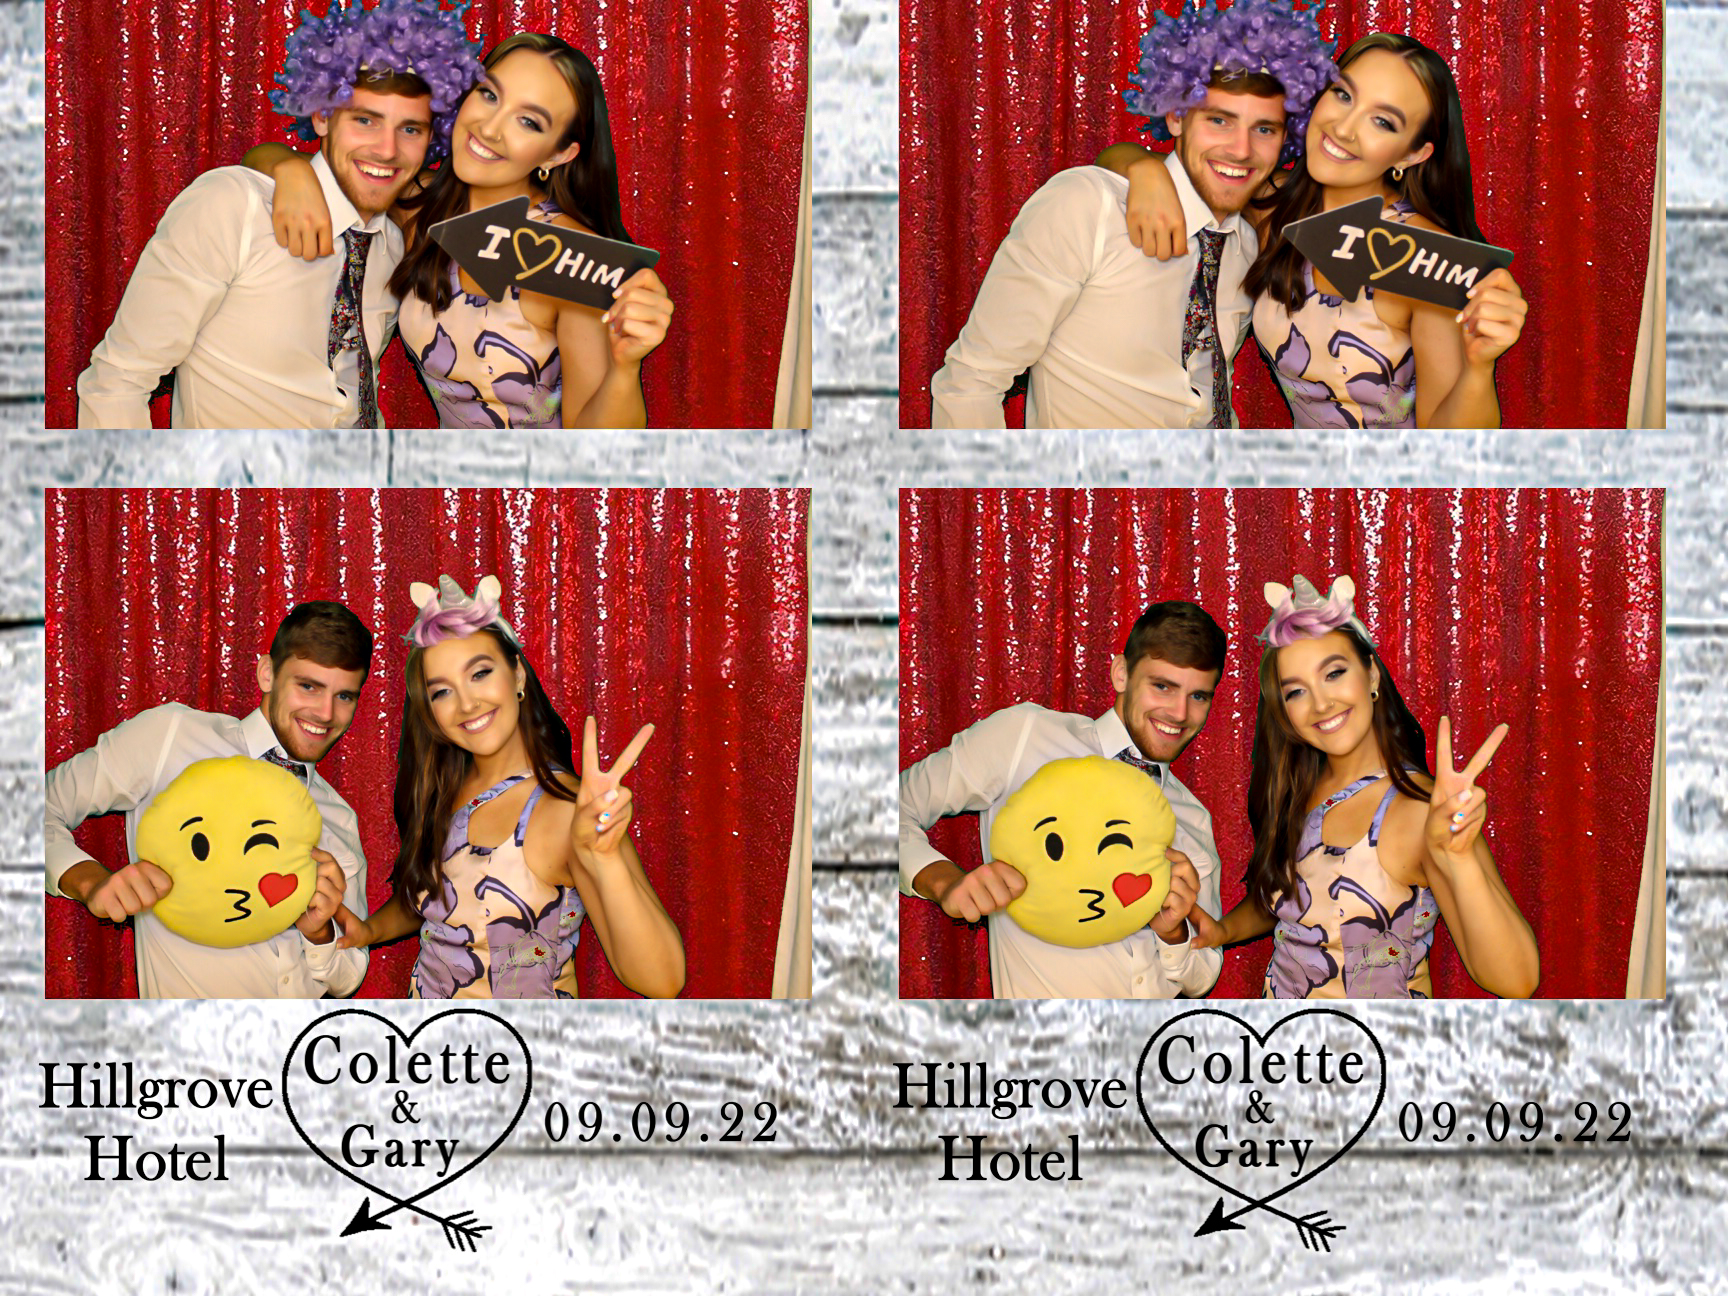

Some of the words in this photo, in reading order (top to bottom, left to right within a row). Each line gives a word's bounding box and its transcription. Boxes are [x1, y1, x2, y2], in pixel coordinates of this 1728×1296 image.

[477, 224, 511, 260] I
[554, 247, 626, 289] HIM
[1331, 224, 1365, 260] I
[1408, 247, 1480, 289] HIM
